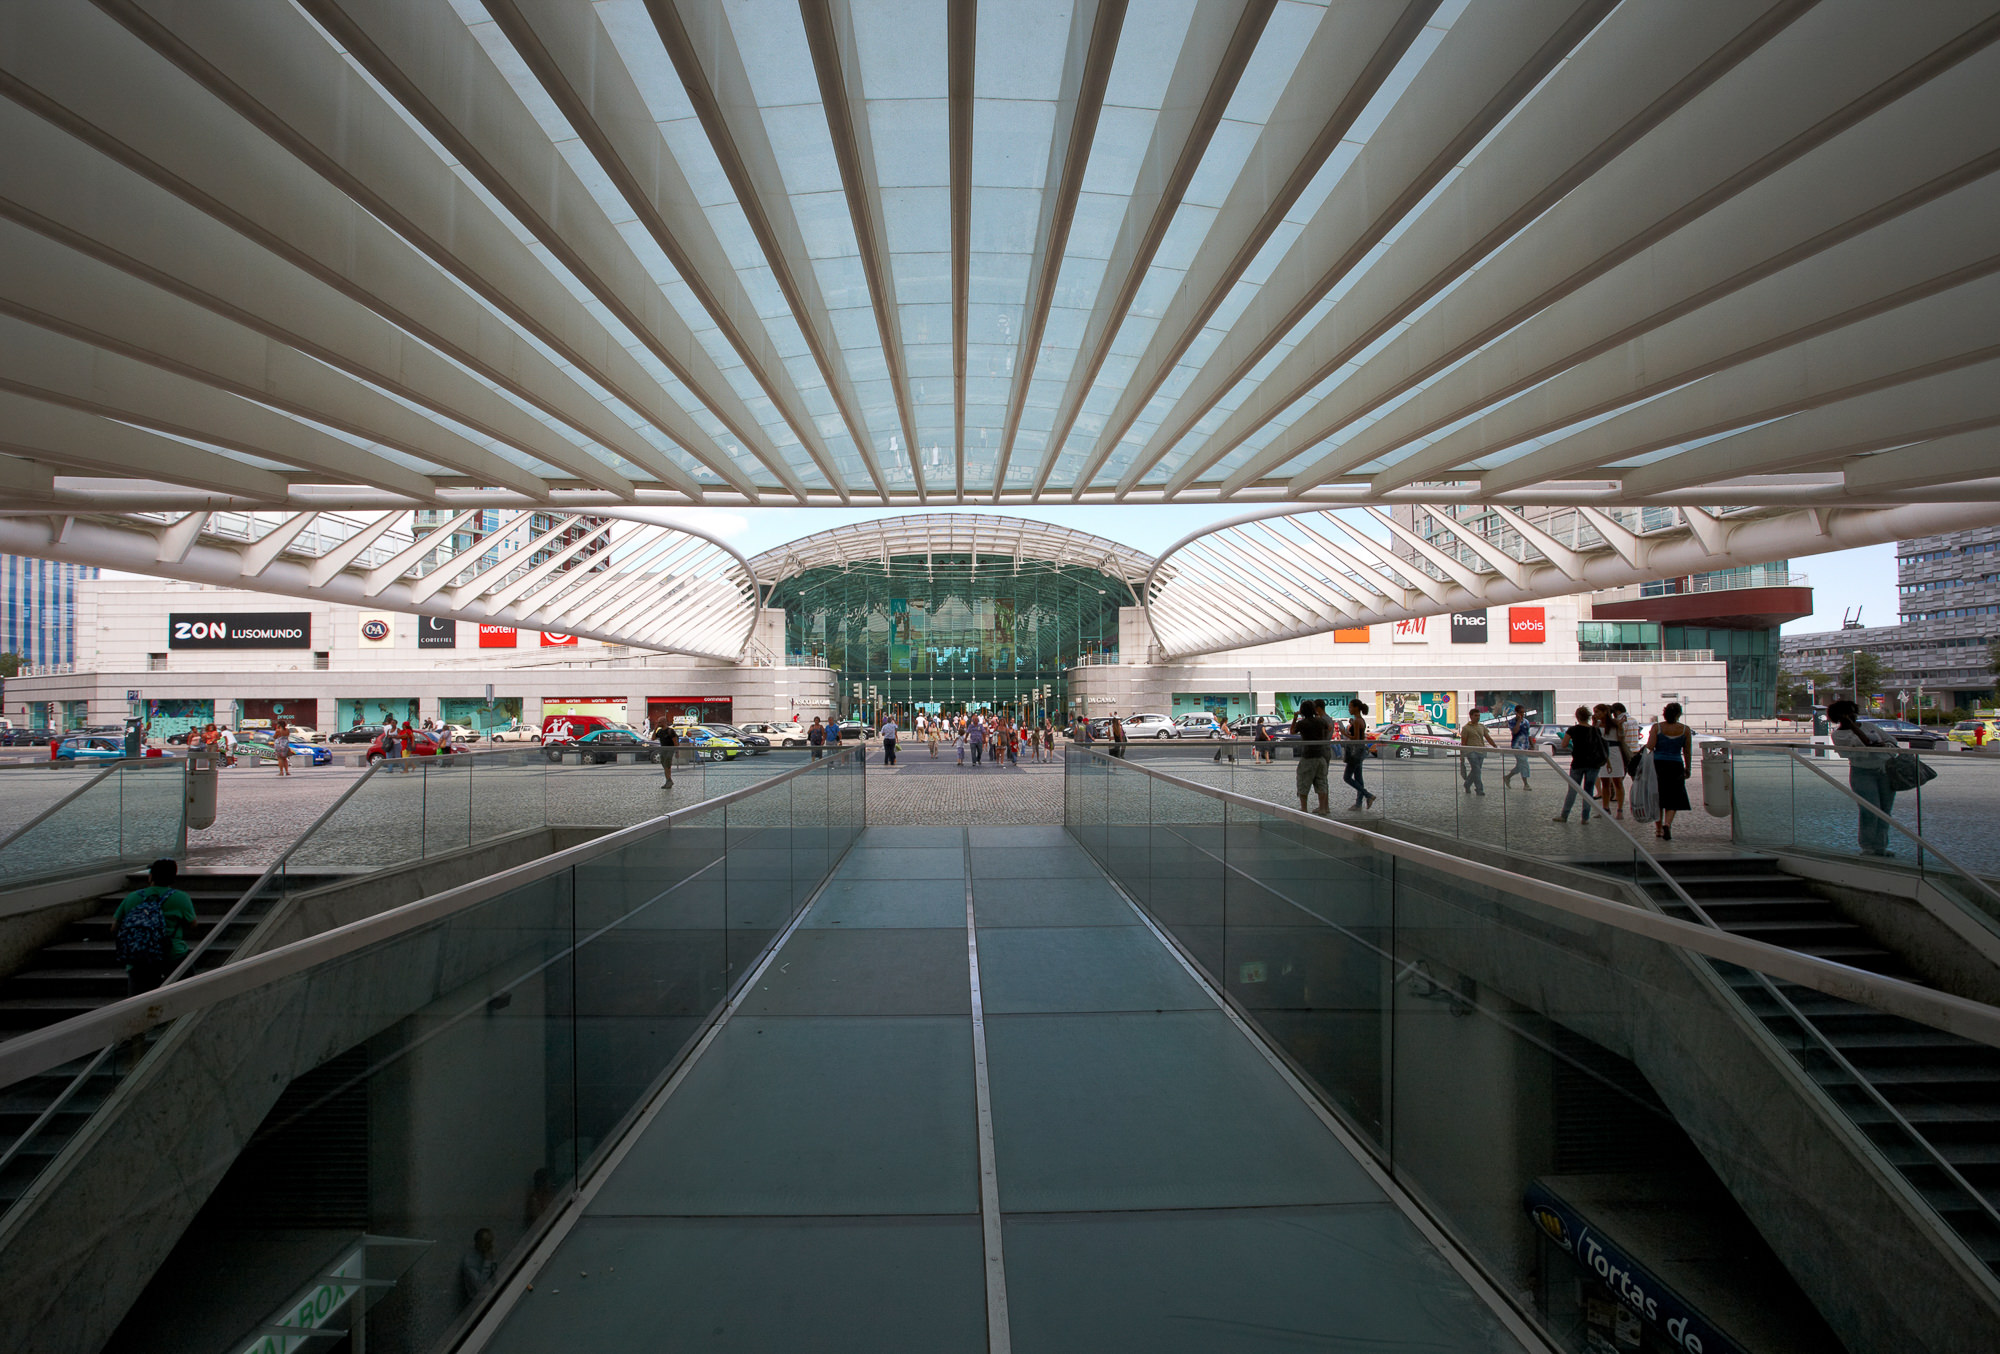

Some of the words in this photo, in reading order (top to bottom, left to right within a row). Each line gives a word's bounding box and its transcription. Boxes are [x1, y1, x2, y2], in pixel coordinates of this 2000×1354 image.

[1396, 617, 1427, 635] H&M
[1453, 614, 1486, 625] fnac
[1512, 620, 1544, 630] vobis
[175, 622, 227, 639] ZON
[231, 629, 303, 639] LUSOMUNDO
[365, 625, 384, 635] C&A
[481, 625, 515, 633] worten
[1424, 704, 1443, 719] 50
[1586, 1236, 1658, 1321] Tortas
[1666, 1316, 1703, 1354] de
